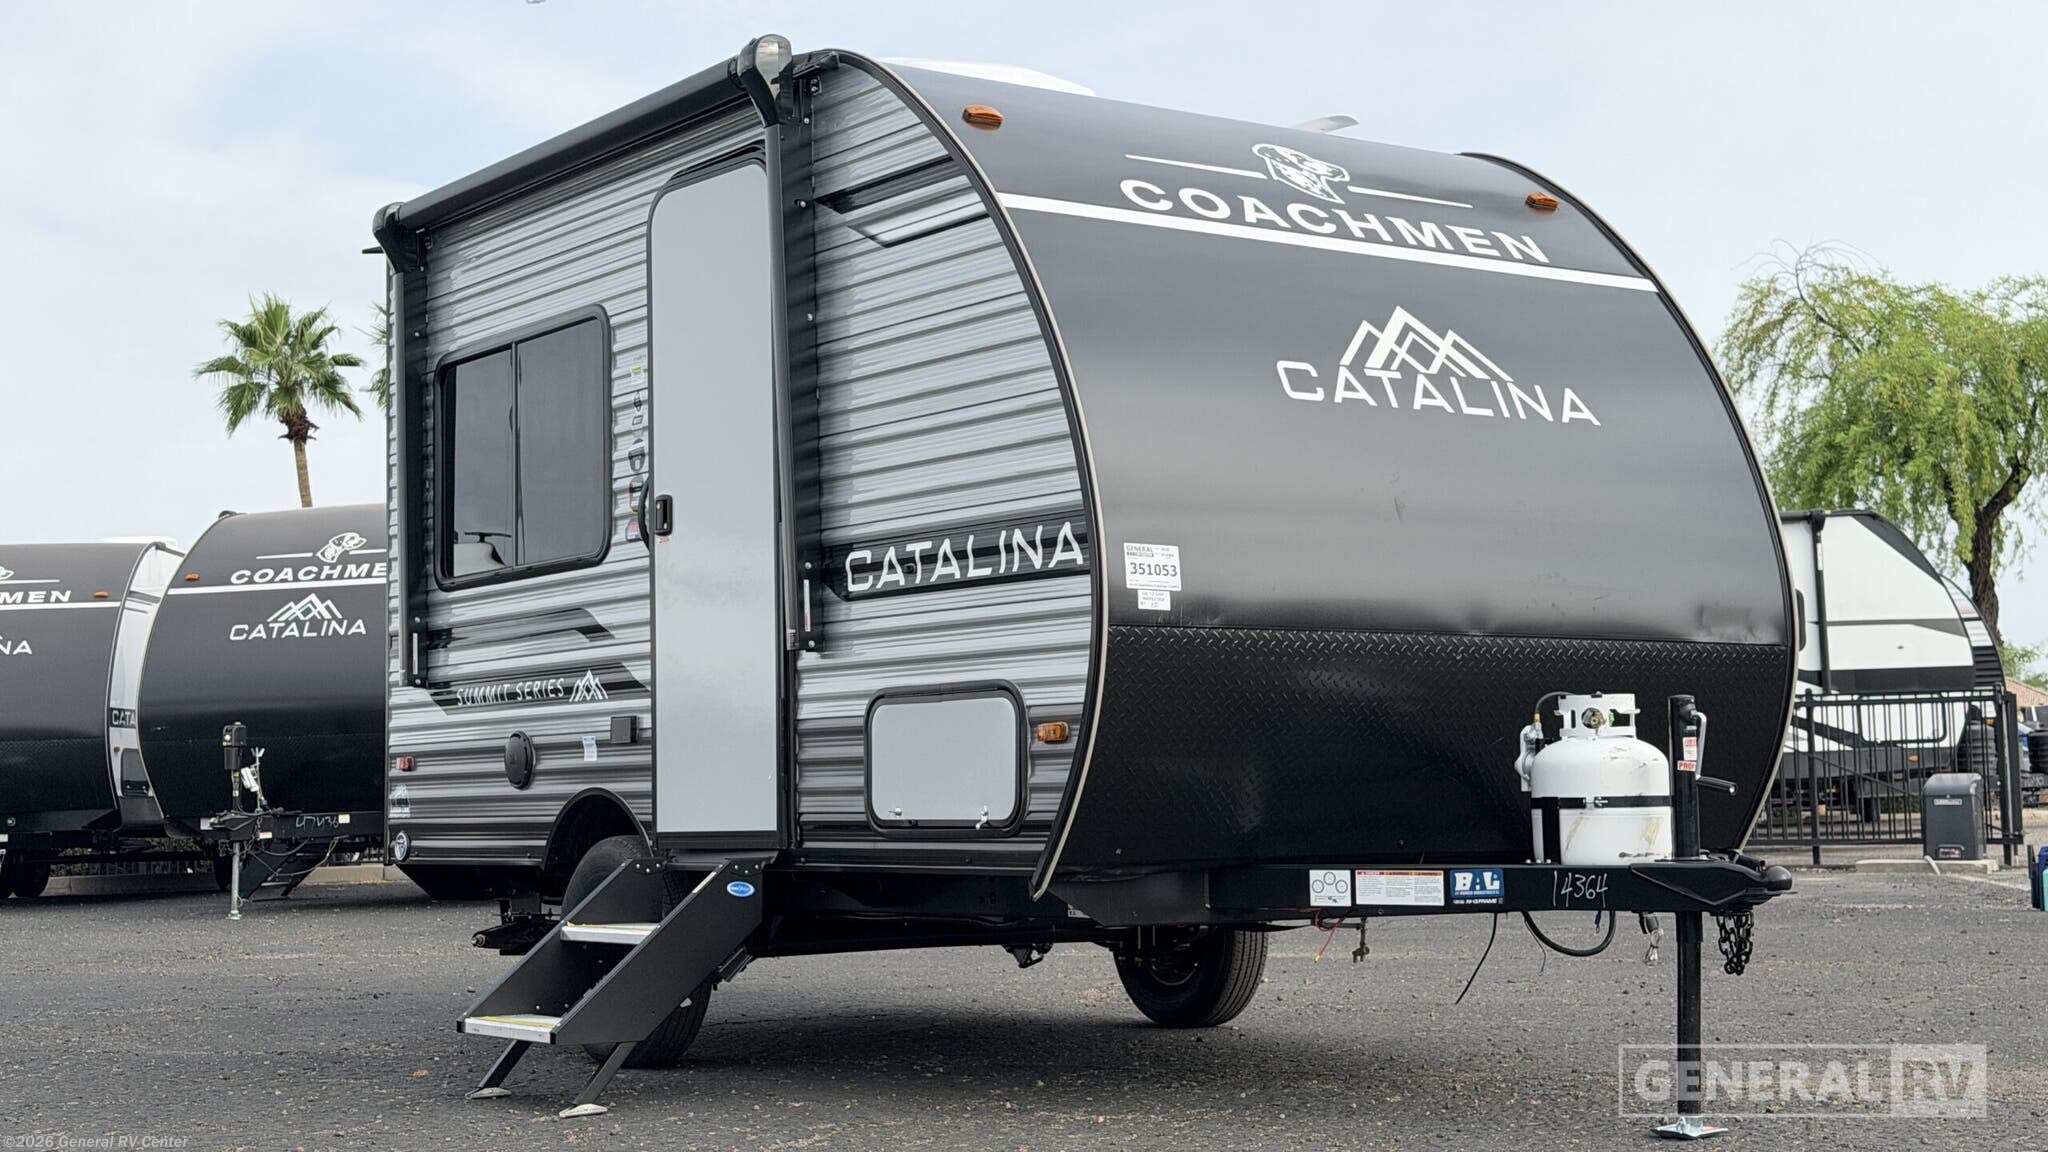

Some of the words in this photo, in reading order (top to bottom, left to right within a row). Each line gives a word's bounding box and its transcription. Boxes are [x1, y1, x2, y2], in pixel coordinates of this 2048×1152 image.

[1120, 180, 1550, 263] COACHMEN
[1276, 360, 1602, 426] CATALINA
[230, 562, 387, 584] COACHME
[845, 521, 1084, 592] CATALINA
[1130, 562, 1178, 577] 351053
[229, 618, 367, 641] CATALINA
[456, 684, 511, 706] SUMMIT
[516, 678, 565, 701] SERIES
[1553, 870, 1609, 908] 14364
